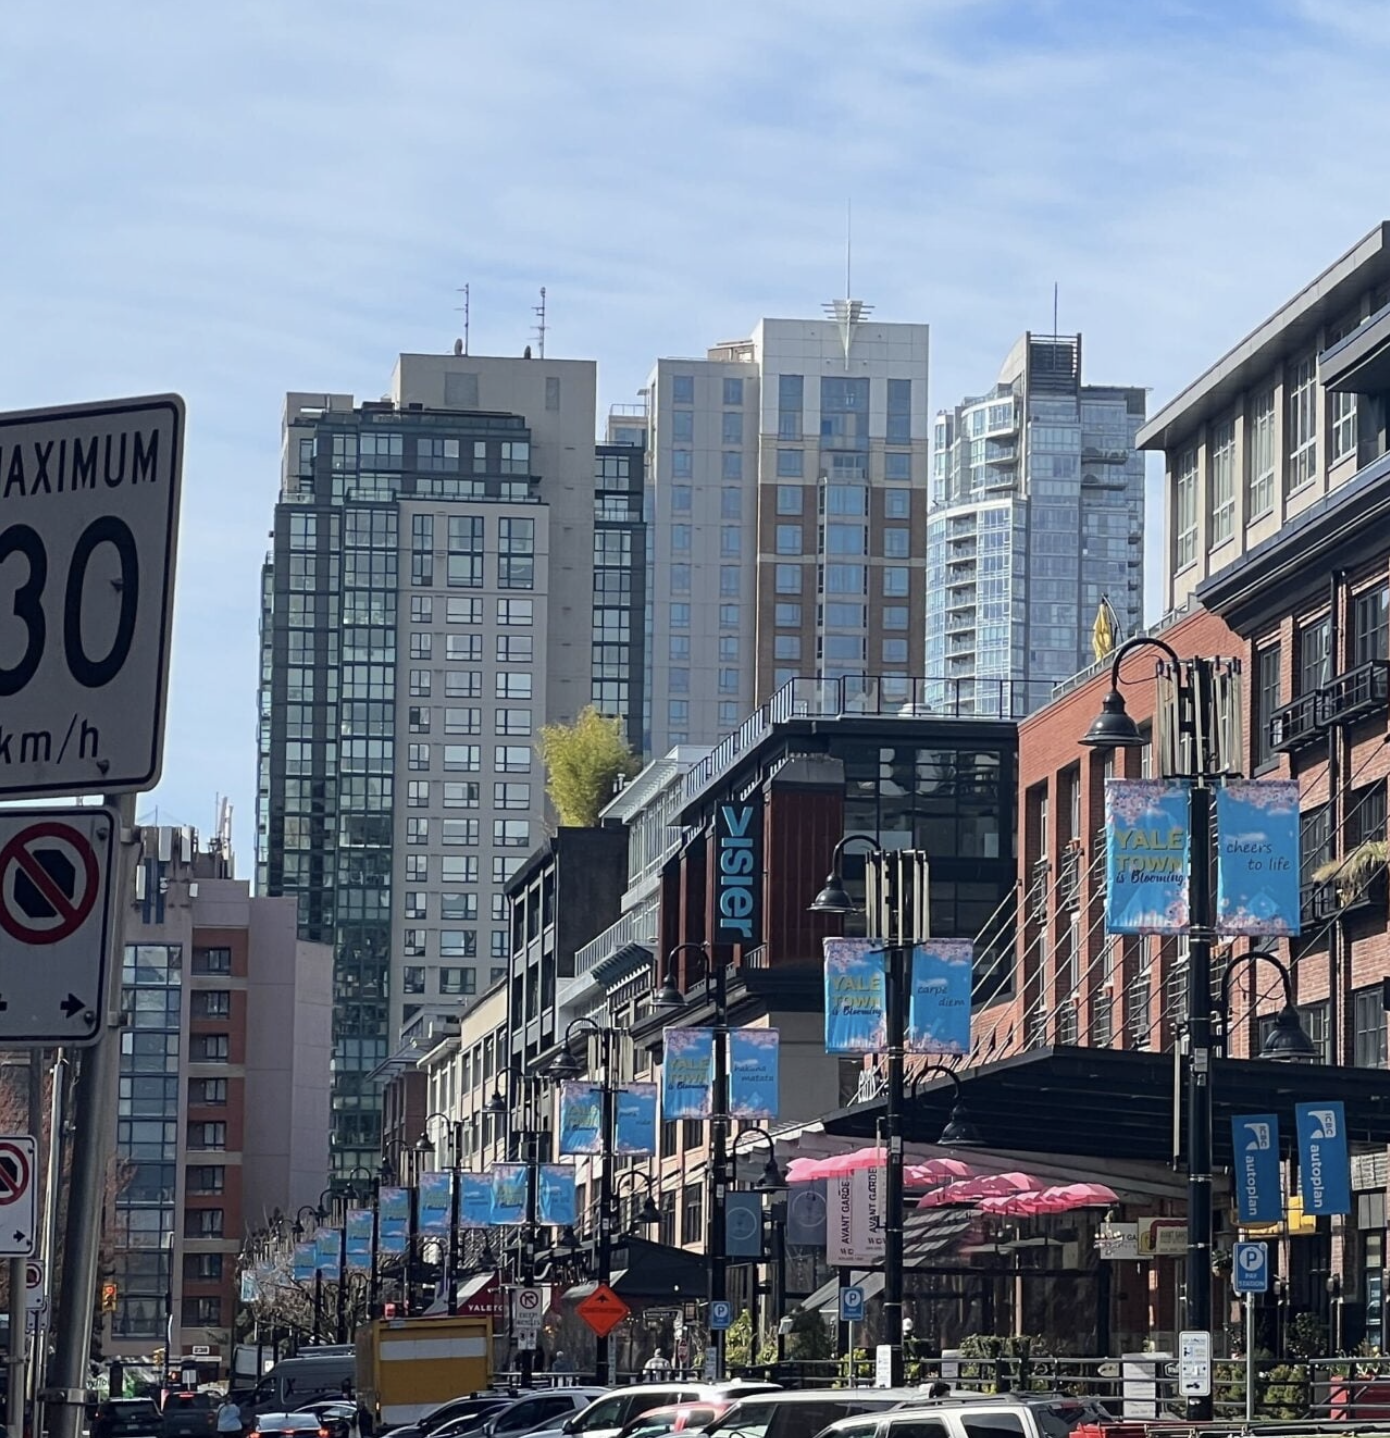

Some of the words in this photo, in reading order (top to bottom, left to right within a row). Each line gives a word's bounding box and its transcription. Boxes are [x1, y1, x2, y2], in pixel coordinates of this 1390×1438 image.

[0, 429, 159, 498] AXIMUM
[0, 515, 139, 696] 30
[0, 714, 99, 764] km/h
[1115, 829, 1184, 850] YALE
[1226, 840, 1272, 854] cheers
[1116, 855, 1184, 874] TOWN
[1248, 857, 1262, 872] to
[1269, 856, 1290, 872] life
[1130, 870, 1184, 885] Blooming
[832, 976, 881, 991] YALE
[1246, 1156, 1258, 1215] autoplan
[1310, 1144, 1324, 1208] autoplan
[841, 1216, 850, 1244] AVANT
[468, 1304, 503, 1312] YALETO
